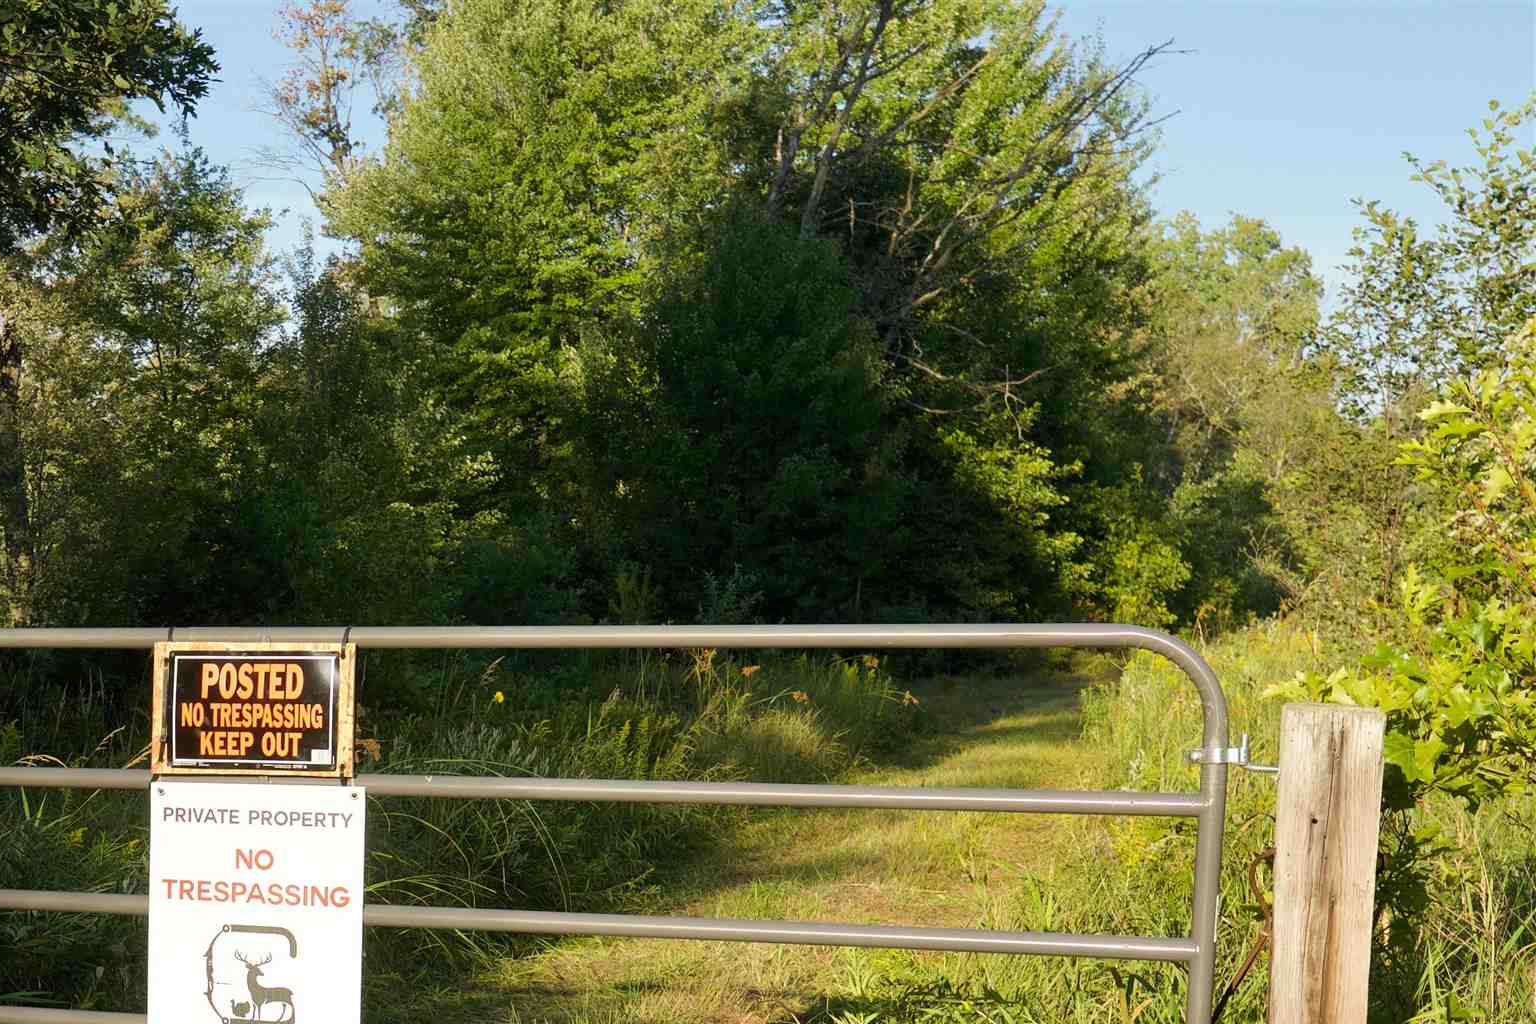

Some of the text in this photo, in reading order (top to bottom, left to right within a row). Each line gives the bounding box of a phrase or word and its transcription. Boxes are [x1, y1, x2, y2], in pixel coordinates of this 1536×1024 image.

[201, 662, 305, 700] POSTED
[181, 702, 324, 729] NO TRESPASSING
[200, 731, 303, 757] KEEP OUT
[163, 807, 353, 829] PRIVATE PROPERTY
[235, 848, 274, 871] NO
[162, 879, 351, 908] TRESPASSING
